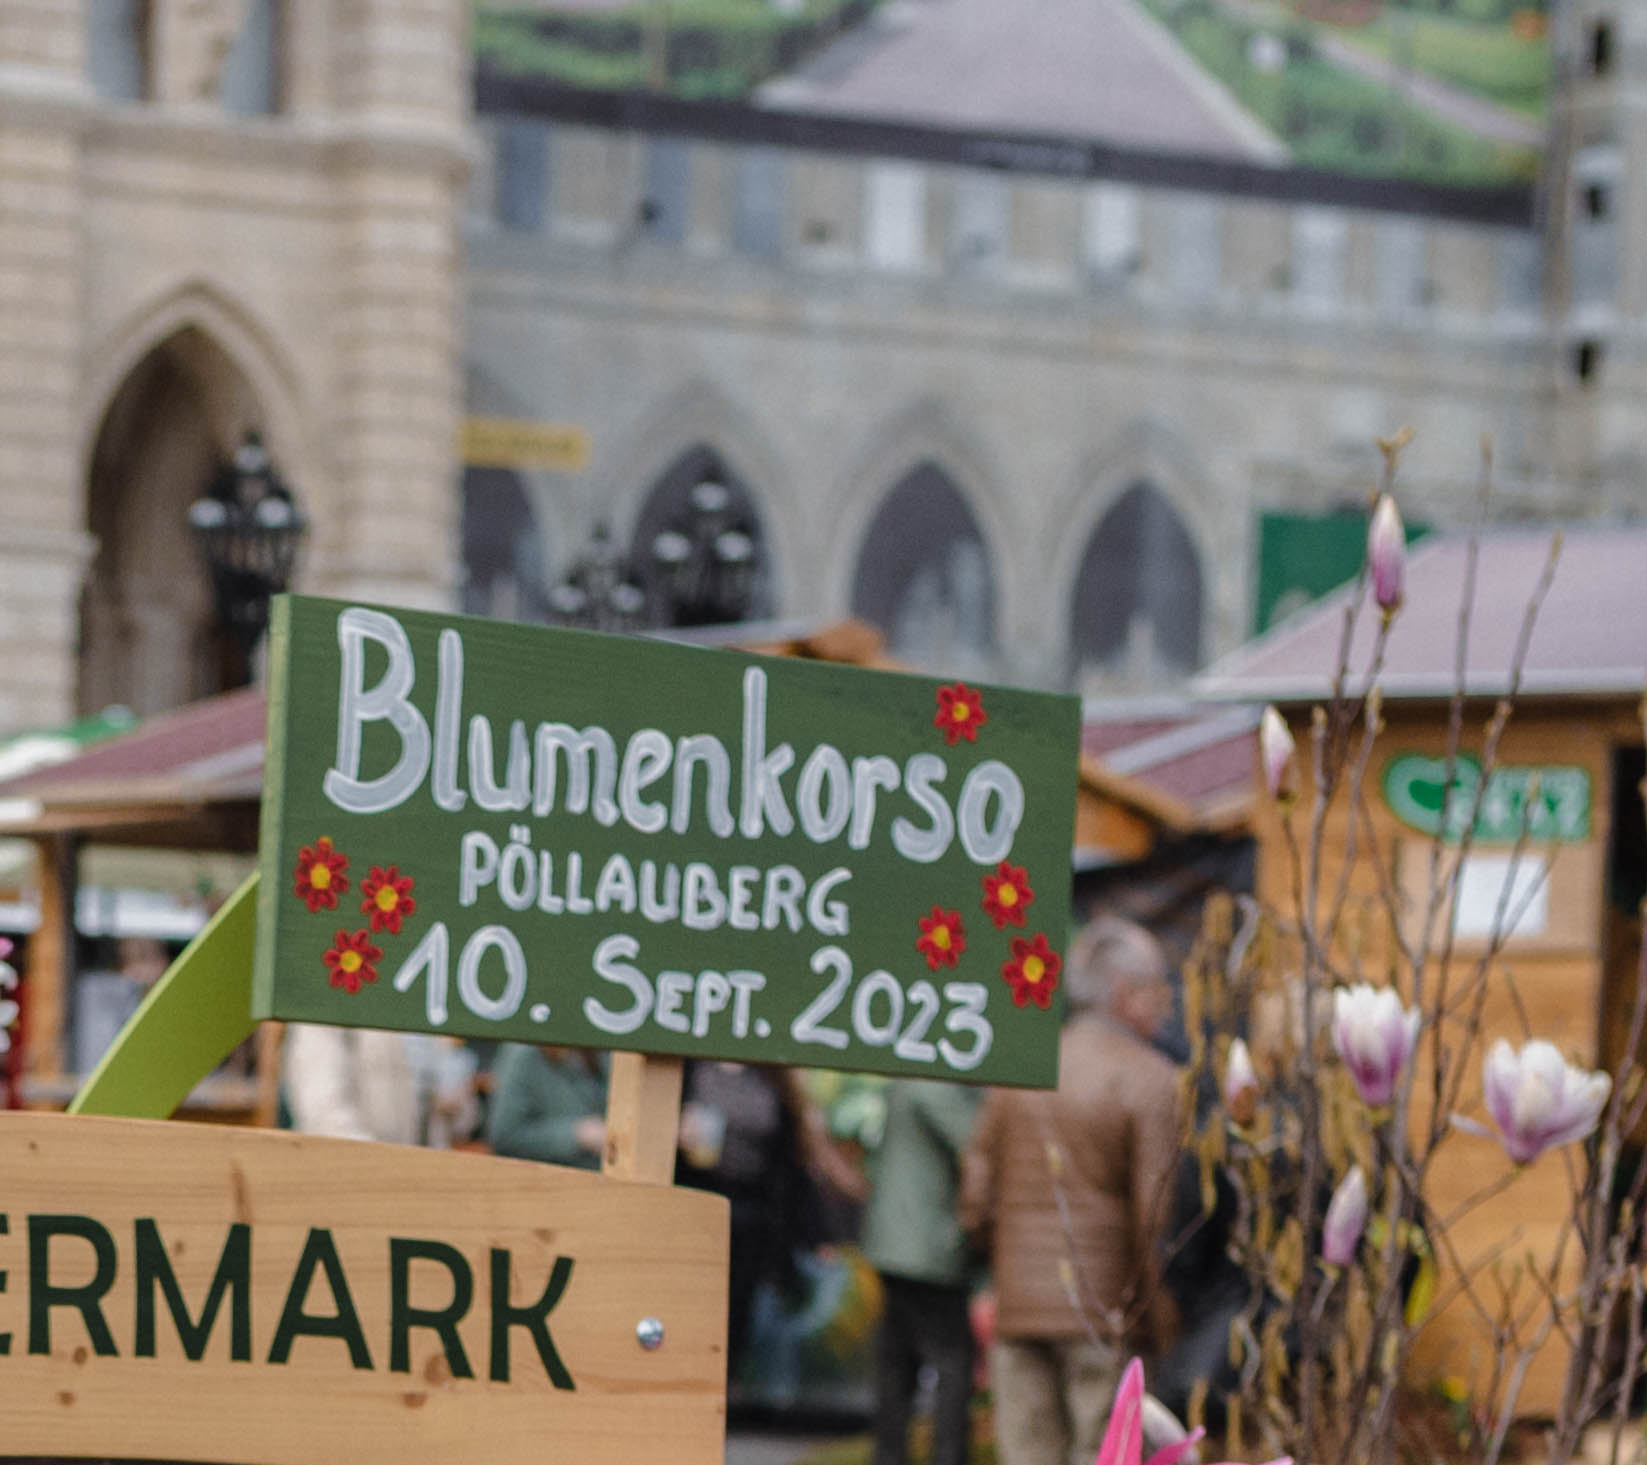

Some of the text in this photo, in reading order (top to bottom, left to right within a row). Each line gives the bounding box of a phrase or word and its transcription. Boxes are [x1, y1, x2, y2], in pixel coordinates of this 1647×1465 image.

[323, 607, 1026, 866] Blumenkorso
[459, 825, 853, 938] PÖLLAUBERG
[393, 921, 552, 1027] 10.
[790, 945, 994, 1072] 2023
